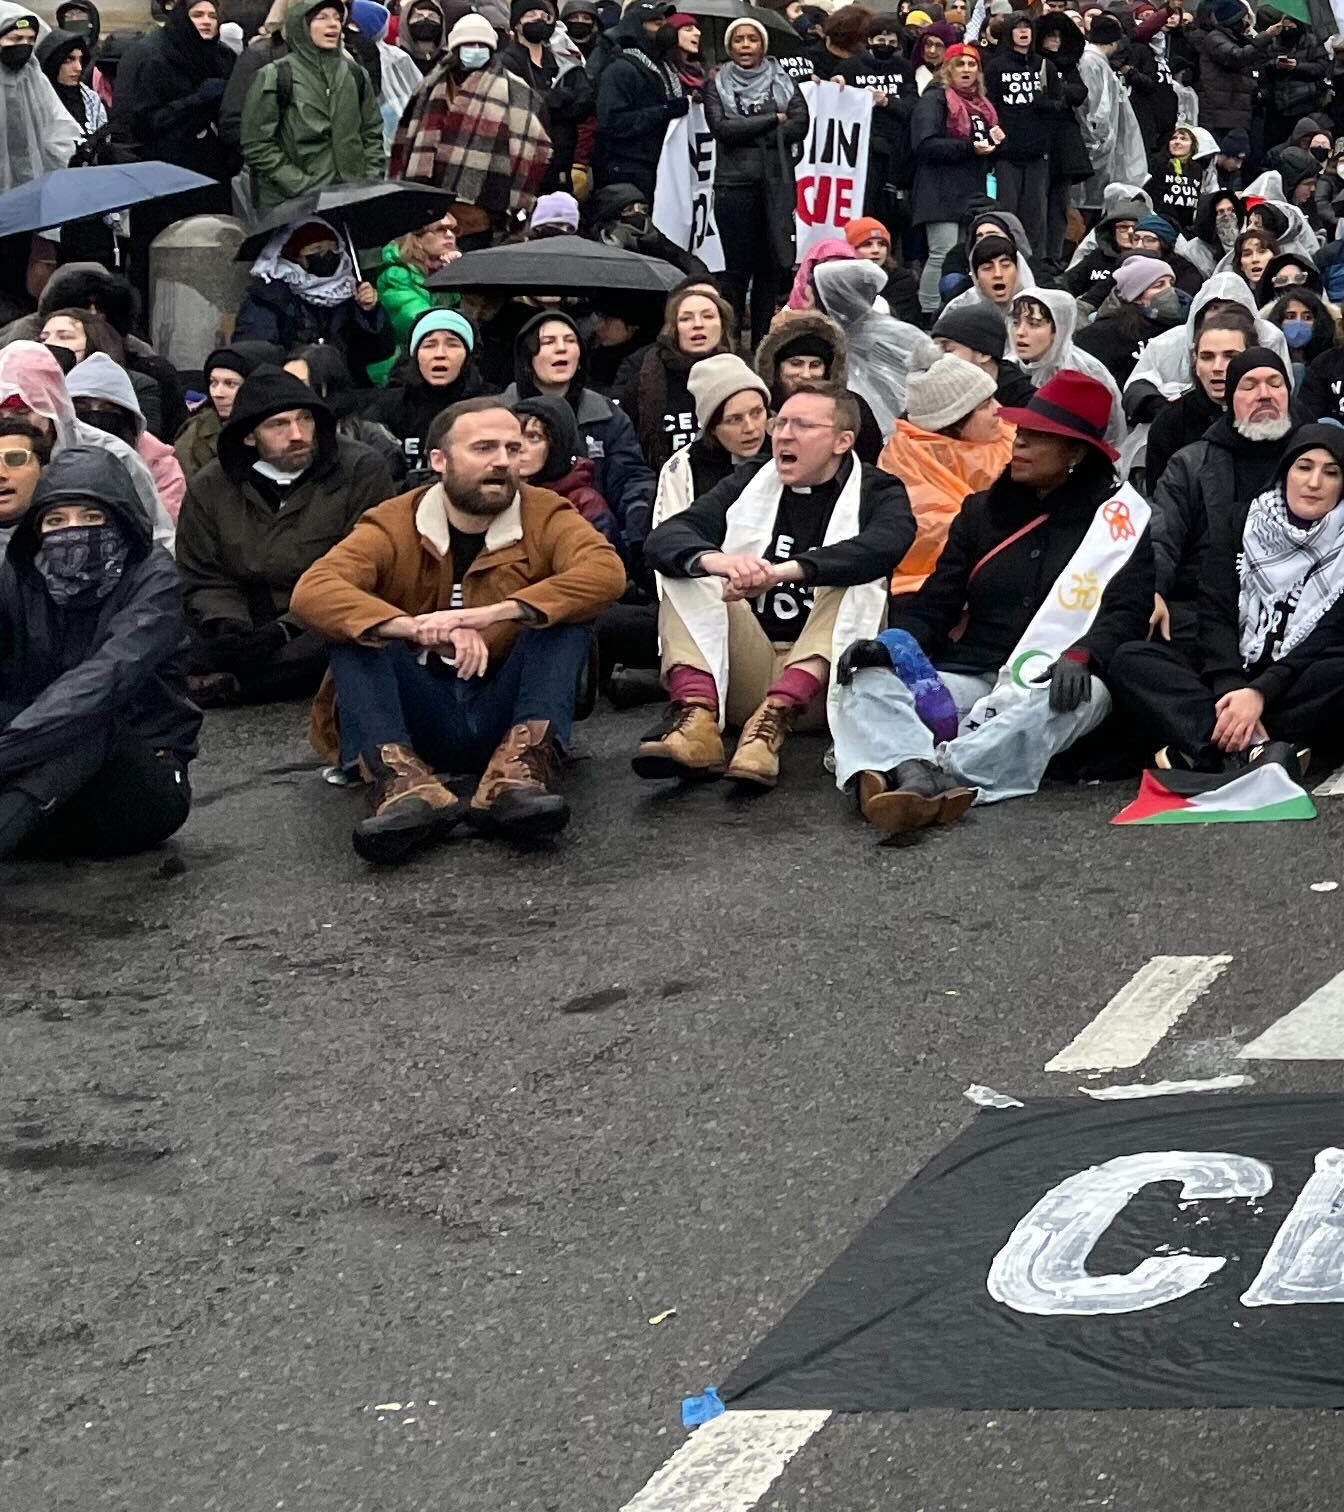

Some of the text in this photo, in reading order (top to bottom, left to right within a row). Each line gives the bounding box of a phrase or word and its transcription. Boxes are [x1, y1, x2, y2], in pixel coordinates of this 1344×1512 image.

[780, 57, 803, 68] NOT
[855, 74, 904, 85] NOT IN
[1000, 72, 1031, 81] NOT
